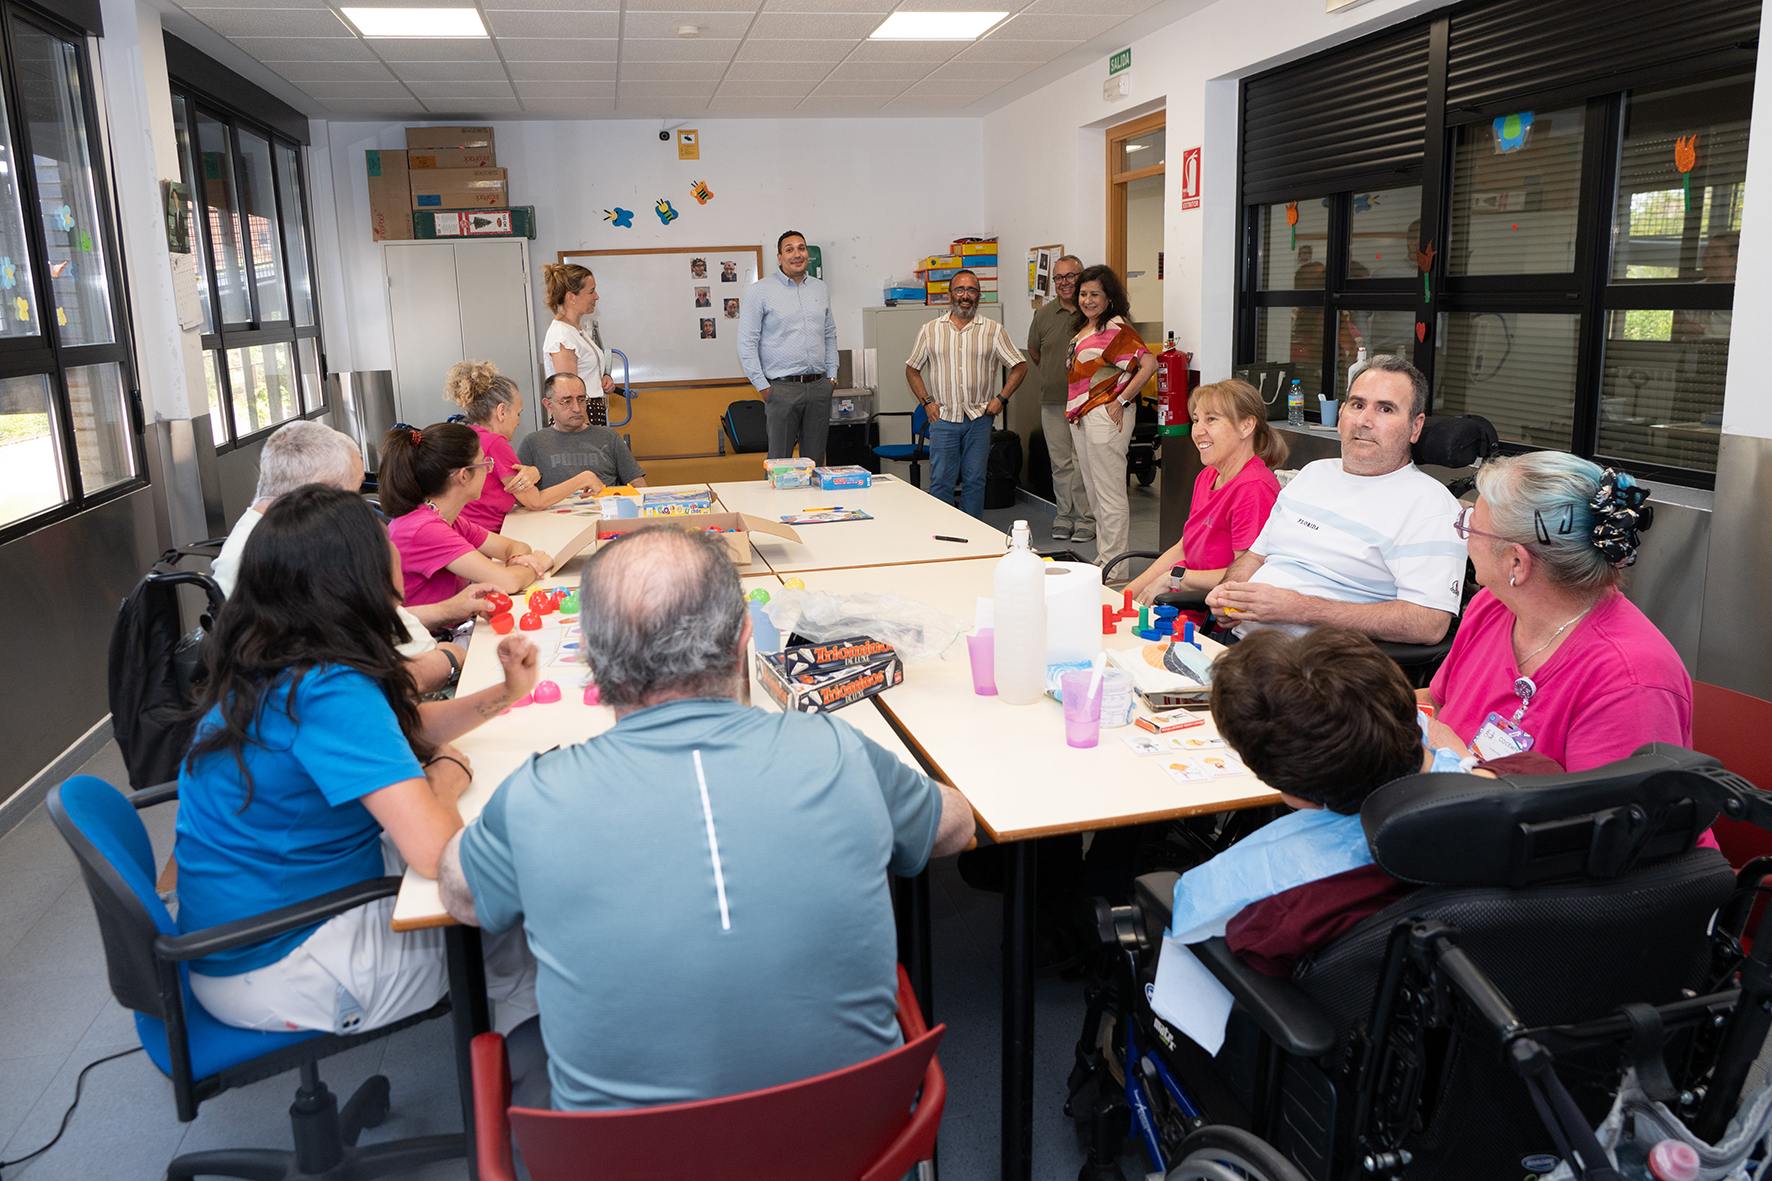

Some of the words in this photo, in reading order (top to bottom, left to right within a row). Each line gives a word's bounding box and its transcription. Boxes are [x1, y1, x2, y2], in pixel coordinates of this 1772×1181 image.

[1110, 54, 1130, 71] SALIDA
[550, 452, 599, 467] PUMA
[1297, 518, 1320, 531] FLORIDA
[821, 670, 885, 705] Triominos
